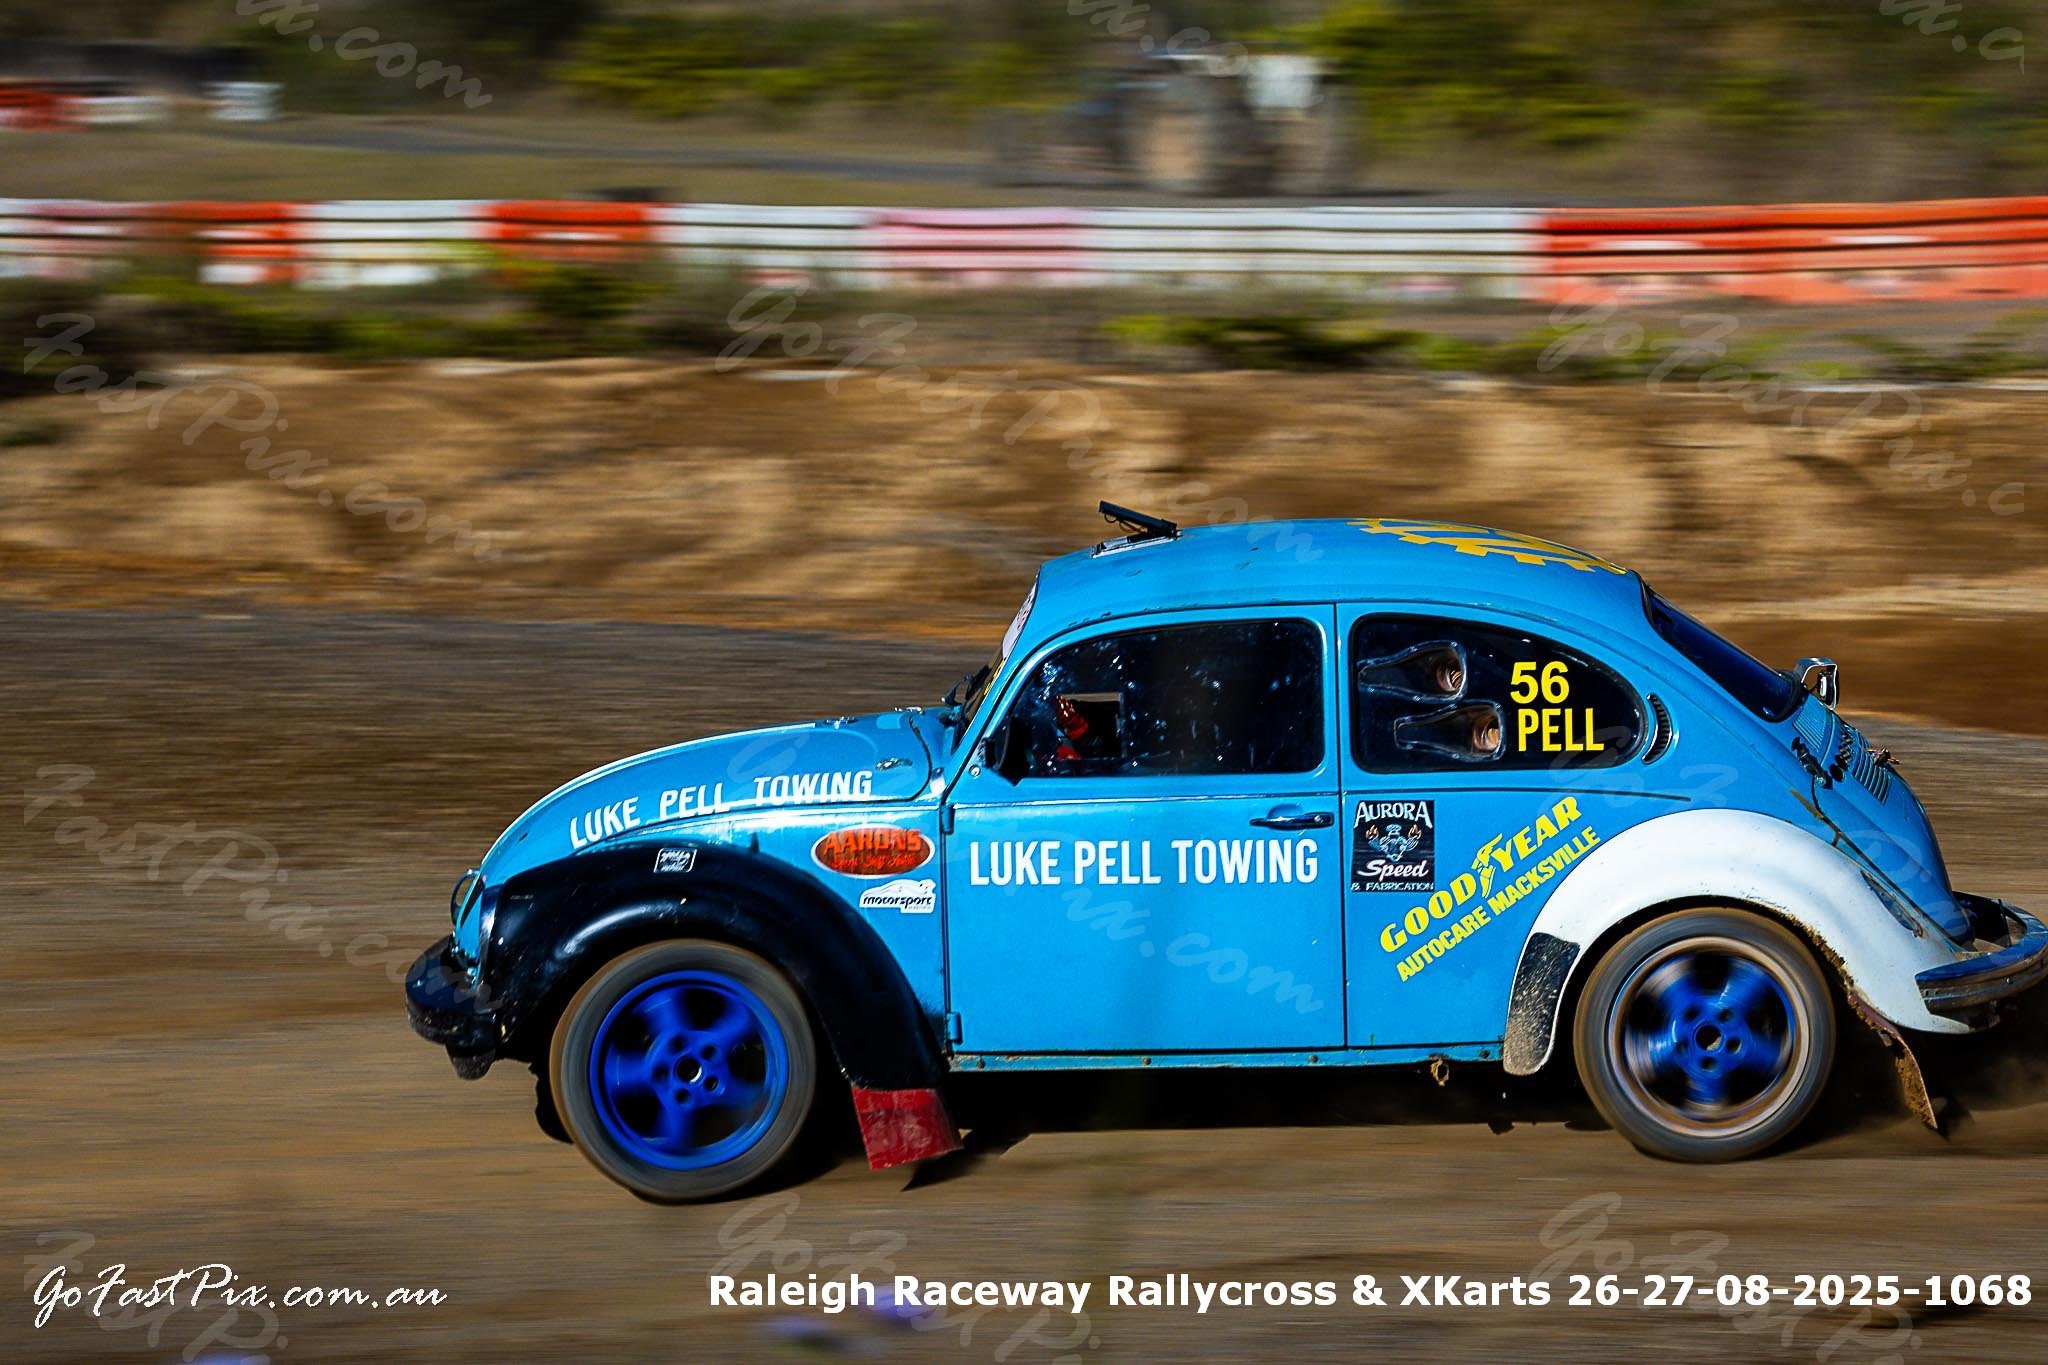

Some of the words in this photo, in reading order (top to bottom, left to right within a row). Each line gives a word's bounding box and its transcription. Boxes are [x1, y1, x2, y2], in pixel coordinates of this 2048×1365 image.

[1510, 661, 1570, 704] 56
[1518, 708, 1604, 752] PELL
[569, 797, 641, 850] LUKE
[659, 780, 731, 820] PELL
[752, 769, 874, 806] TOWING
[1353, 800, 1434, 829] AURORA
[823, 828, 922, 855] AARONS
[970, 841, 1060, 886] LUKE
[1074, 840, 1161, 884] PELL
[1171, 838, 1318, 883] TOWING
[1356, 859, 1430, 882] Speed
[863, 896, 932, 910] motorsport
[1366, 881, 1434, 891] FABRICATION
[1395, 905, 1491, 983] AUTOCARE
[1490, 825, 1602, 916] MACKSVILLE
